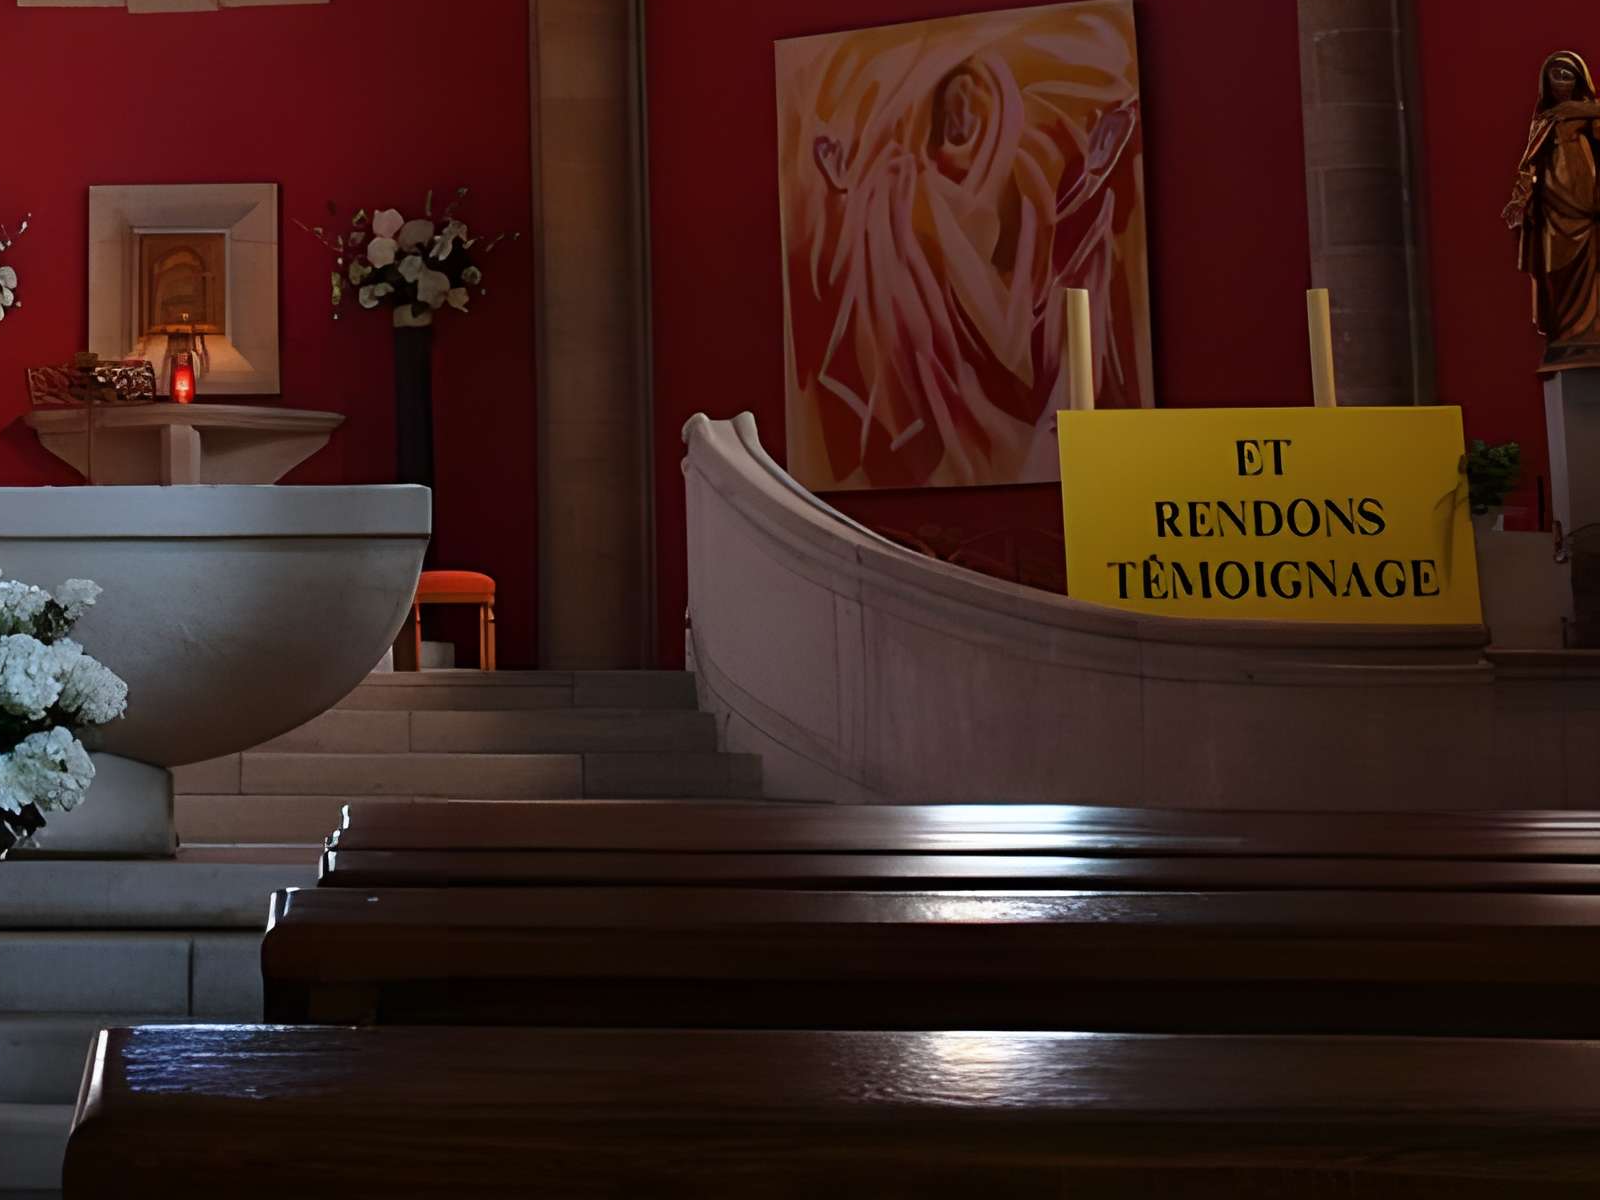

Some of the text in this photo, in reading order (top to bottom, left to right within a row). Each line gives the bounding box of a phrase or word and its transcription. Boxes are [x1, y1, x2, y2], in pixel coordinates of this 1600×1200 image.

[1235, 439, 1292, 476] ET
[1154, 497, 1386, 537] RENDONS
[1106, 553, 1441, 600] TÉMOIGNAGE
